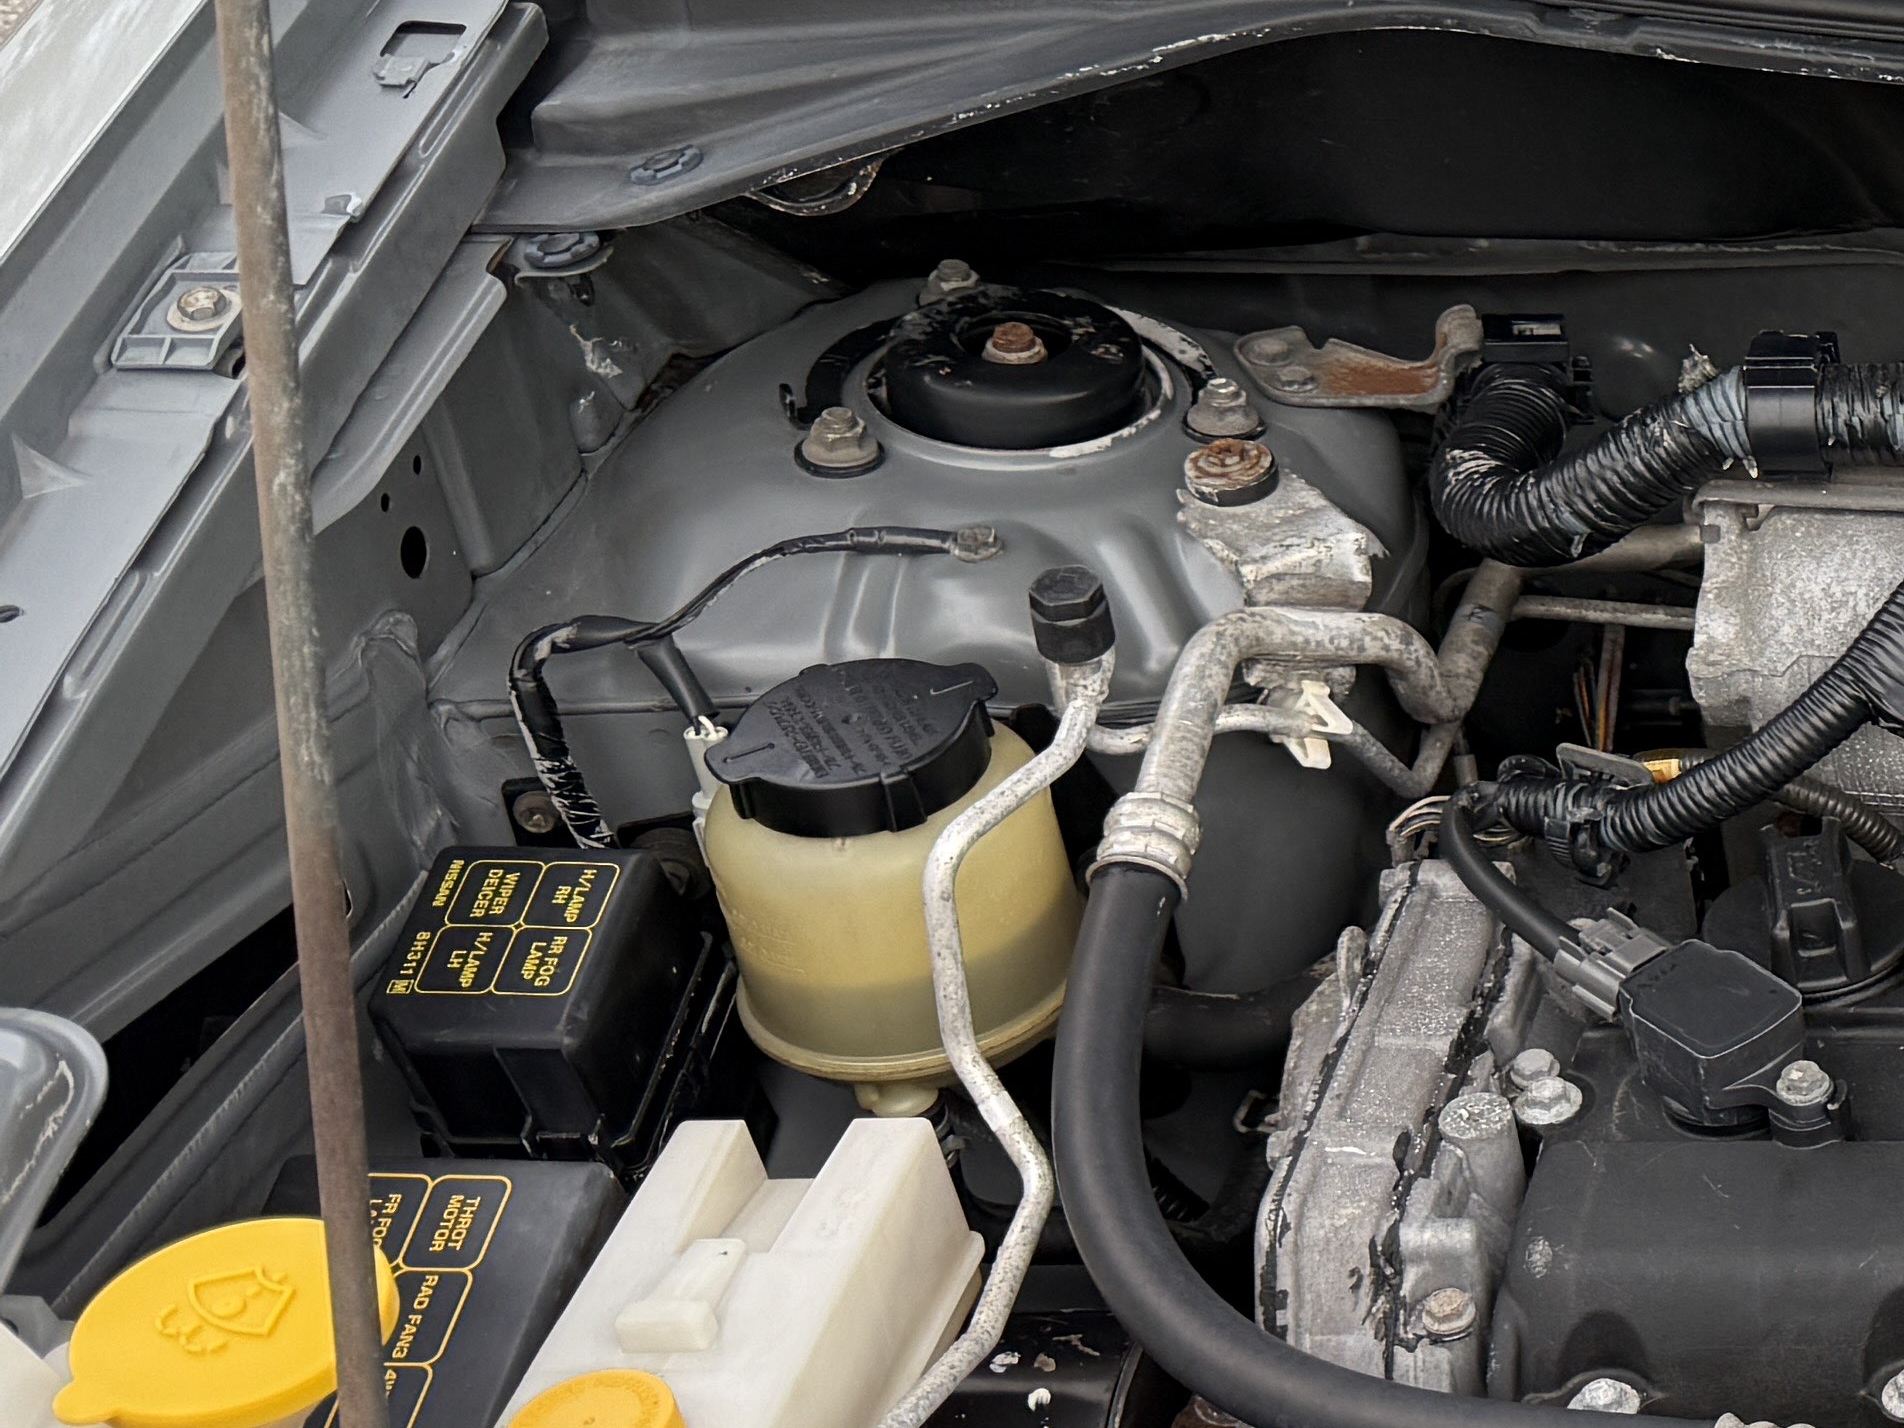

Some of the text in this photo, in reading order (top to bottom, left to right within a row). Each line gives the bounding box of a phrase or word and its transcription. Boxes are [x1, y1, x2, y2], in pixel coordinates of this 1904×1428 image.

[431, 859, 466, 908] NISSAN
[469, 868, 504, 919] DEICER
[488, 871, 521, 916] WIPER
[552, 885, 572, 905] RH
[563, 869, 598, 923] H/LAMP
[399, 930, 432, 976] 8H311
[447, 950, 468, 969] LH
[458, 931, 494, 989] H/LAMP
[520, 941, 548, 980] LAMP
[533, 935, 569, 988] RR FOG
[382, 1192, 402, 1215] FR
[428, 1193, 466, 1252] MOTOR
[447, 1195, 481, 1252] THROT
[391, 1274, 440, 1360] RAD FAN3
